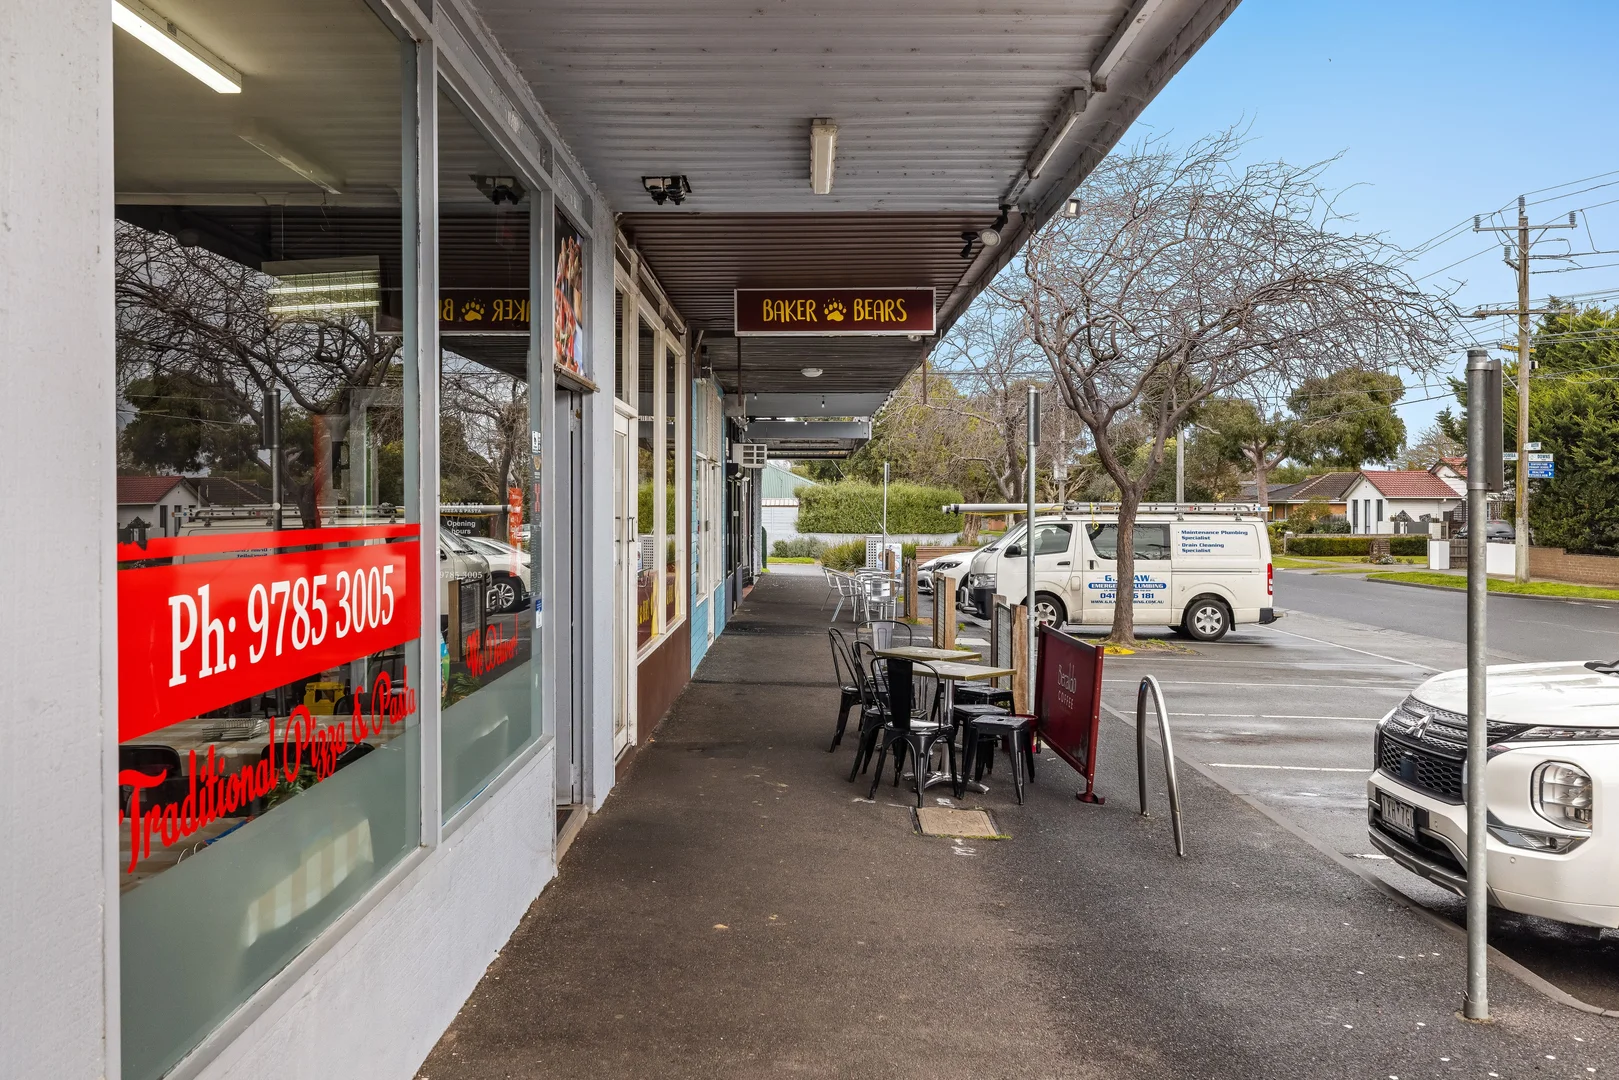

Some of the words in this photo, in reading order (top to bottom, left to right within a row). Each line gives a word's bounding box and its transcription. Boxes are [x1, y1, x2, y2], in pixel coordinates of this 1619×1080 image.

[763, 299, 817, 322] BAKER
[854, 298, 907, 322] BEARS
[168, 584, 236, 687] Ph:
[247, 574, 327, 665] 9785
[335, 564, 394, 638] 3005
[1057, 690, 1074, 710] COFFEE
[118, 716, 280, 874] Traditional
[284, 704, 348, 783] Pizza
[352, 686, 369, 744] &
[371, 665, 417, 735] Pasta
